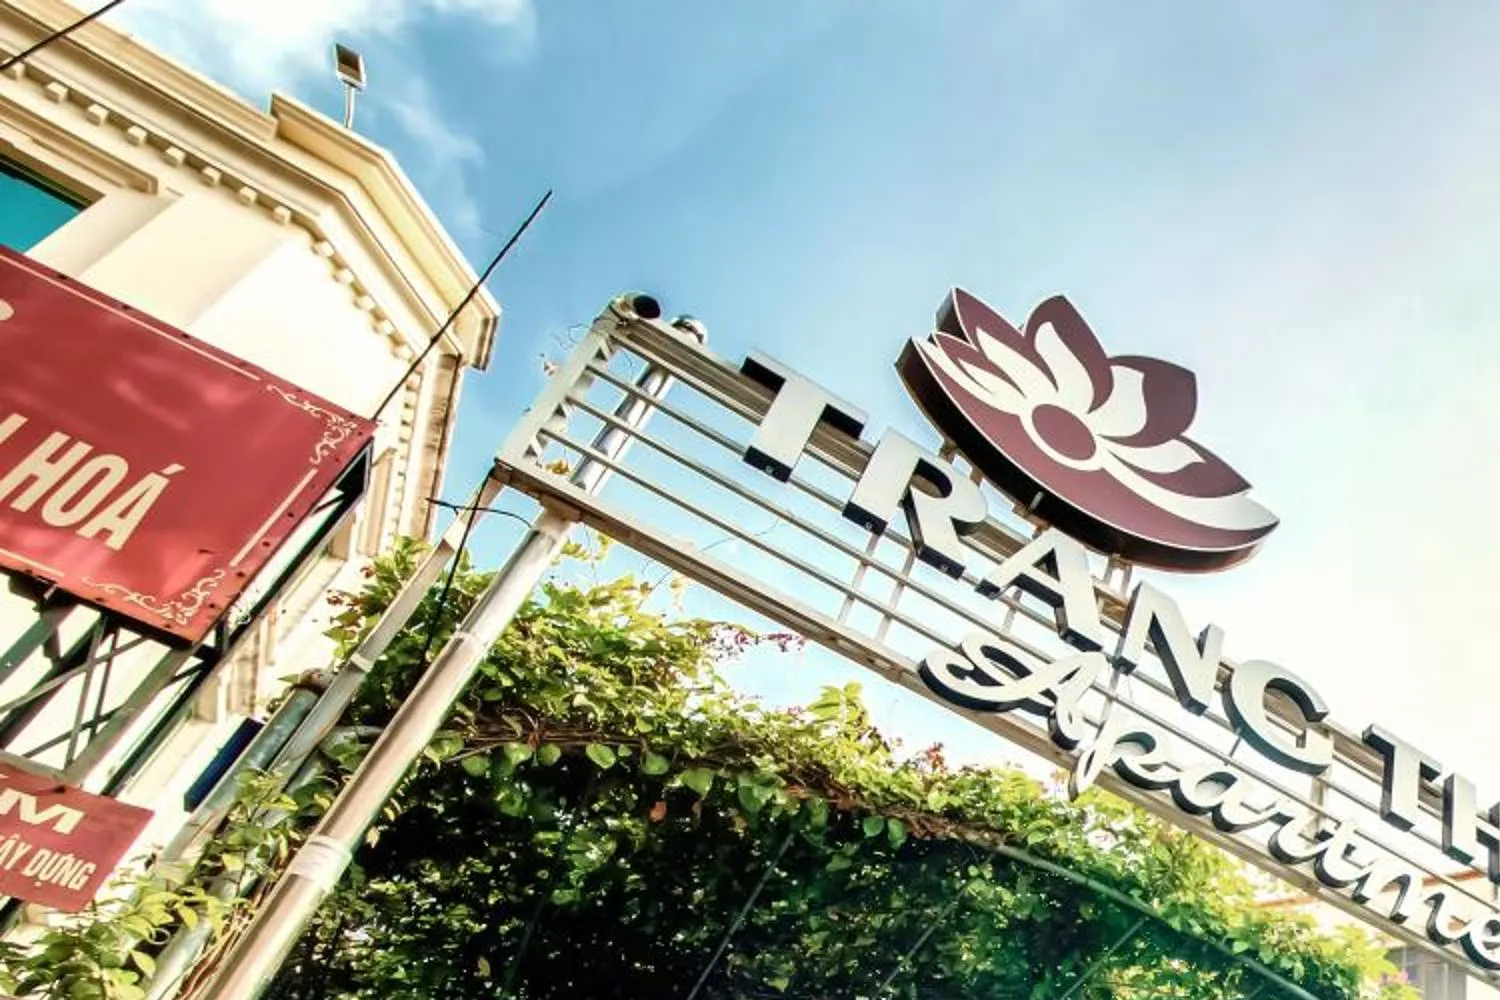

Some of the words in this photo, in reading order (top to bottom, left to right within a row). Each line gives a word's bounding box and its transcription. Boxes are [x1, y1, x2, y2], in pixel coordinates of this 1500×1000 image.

[0, 431, 186, 552] HOÁ
[740, 348, 1334, 776] TRANG
[0, 776, 85, 835] M
[0, 834, 32, 871] ÂY
